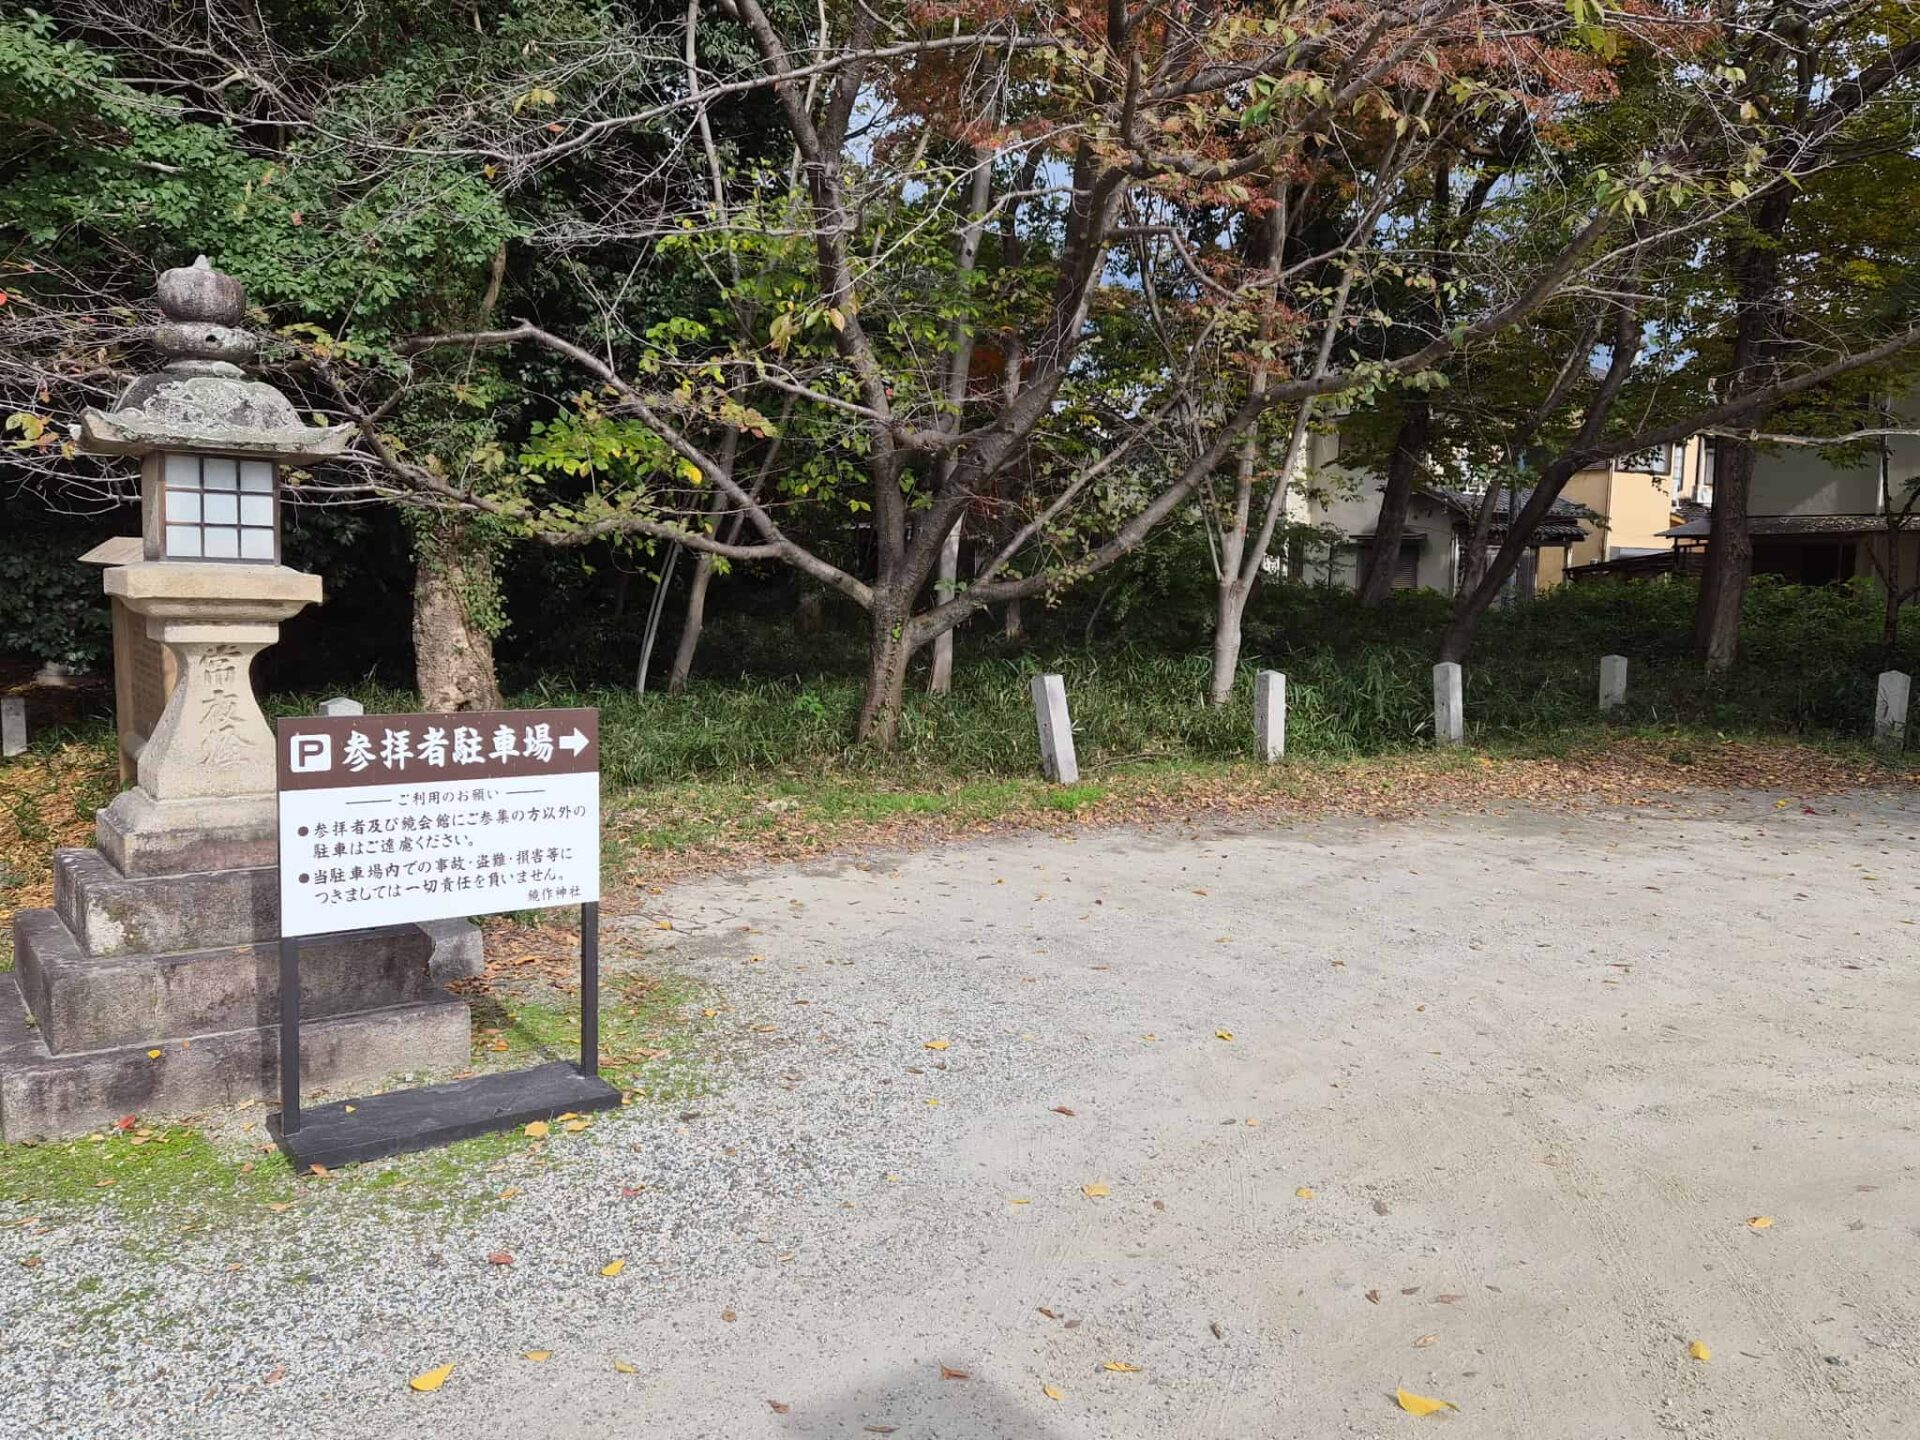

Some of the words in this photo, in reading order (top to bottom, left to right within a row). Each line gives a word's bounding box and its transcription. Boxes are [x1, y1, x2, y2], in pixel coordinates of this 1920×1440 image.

[299, 741, 324, 767] P
[341, 723, 553, 774] 参拝者駐車場
[398, 788, 499, 806] ご利用のお願い
[314, 805, 586, 839] 参拝者及び鏡会館にご参集の方以外の
[313, 833, 474, 859] 駐車はご遠慮ください。
[315, 868, 565, 904] つきましては一切責任を負いません。
